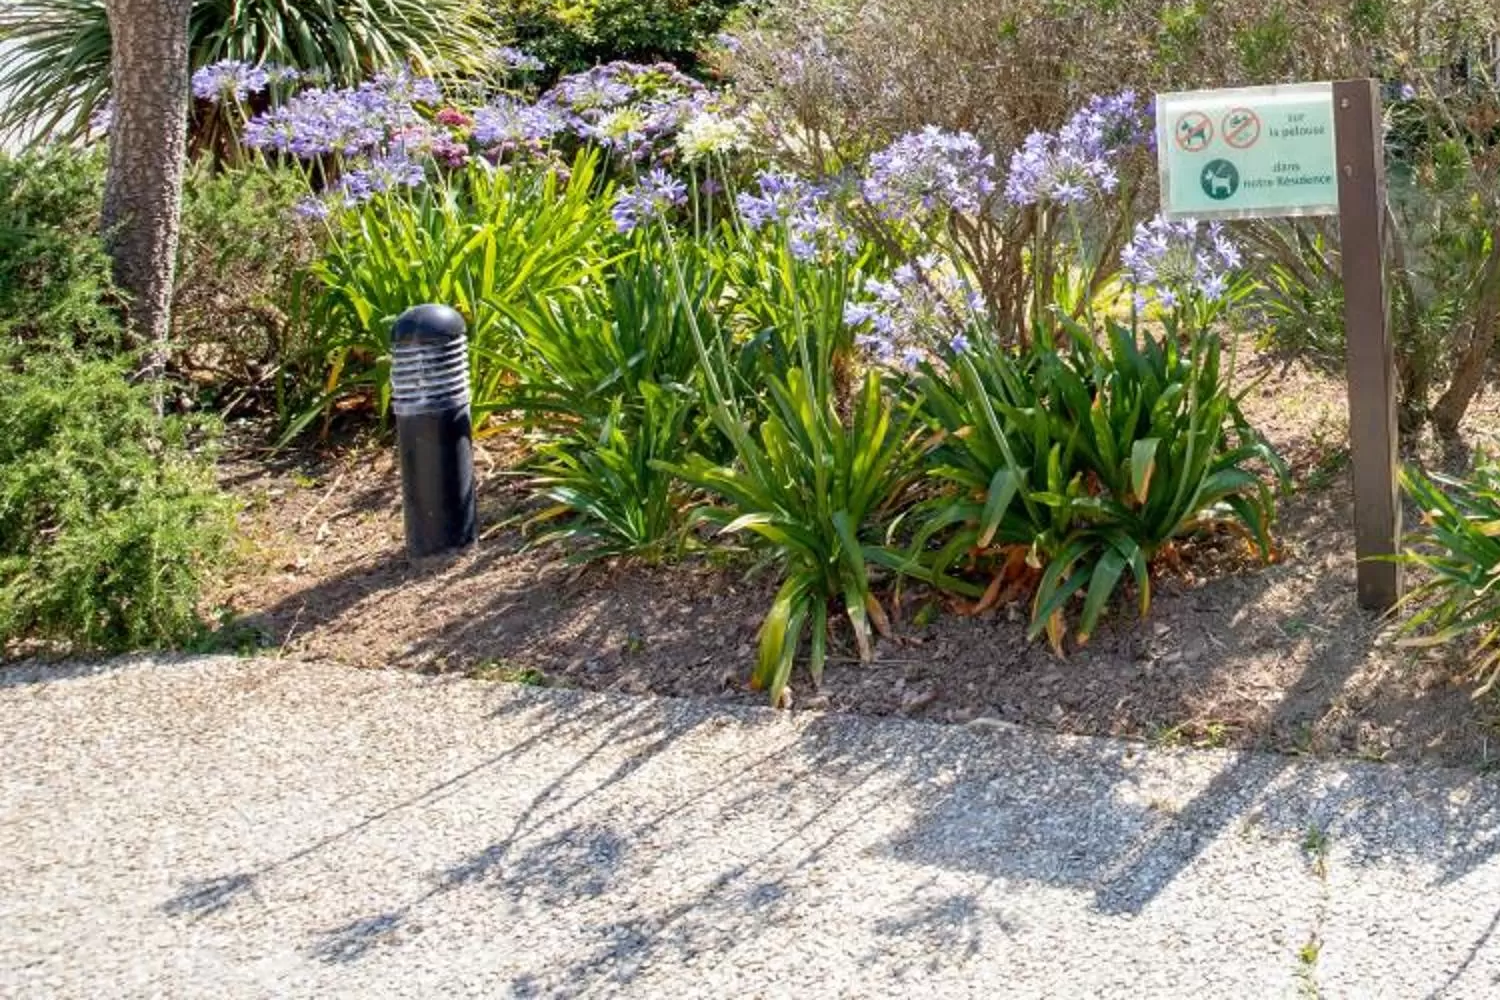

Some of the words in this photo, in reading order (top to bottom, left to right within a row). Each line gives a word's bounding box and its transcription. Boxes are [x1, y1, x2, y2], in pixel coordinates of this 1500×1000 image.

[1287, 112, 1305, 122] sur
[1269, 126, 1279, 137] la
[1281, 124, 1325, 138] pelouse
[1272, 161, 1301, 173] dans
[1243, 177, 1275, 189] notre
